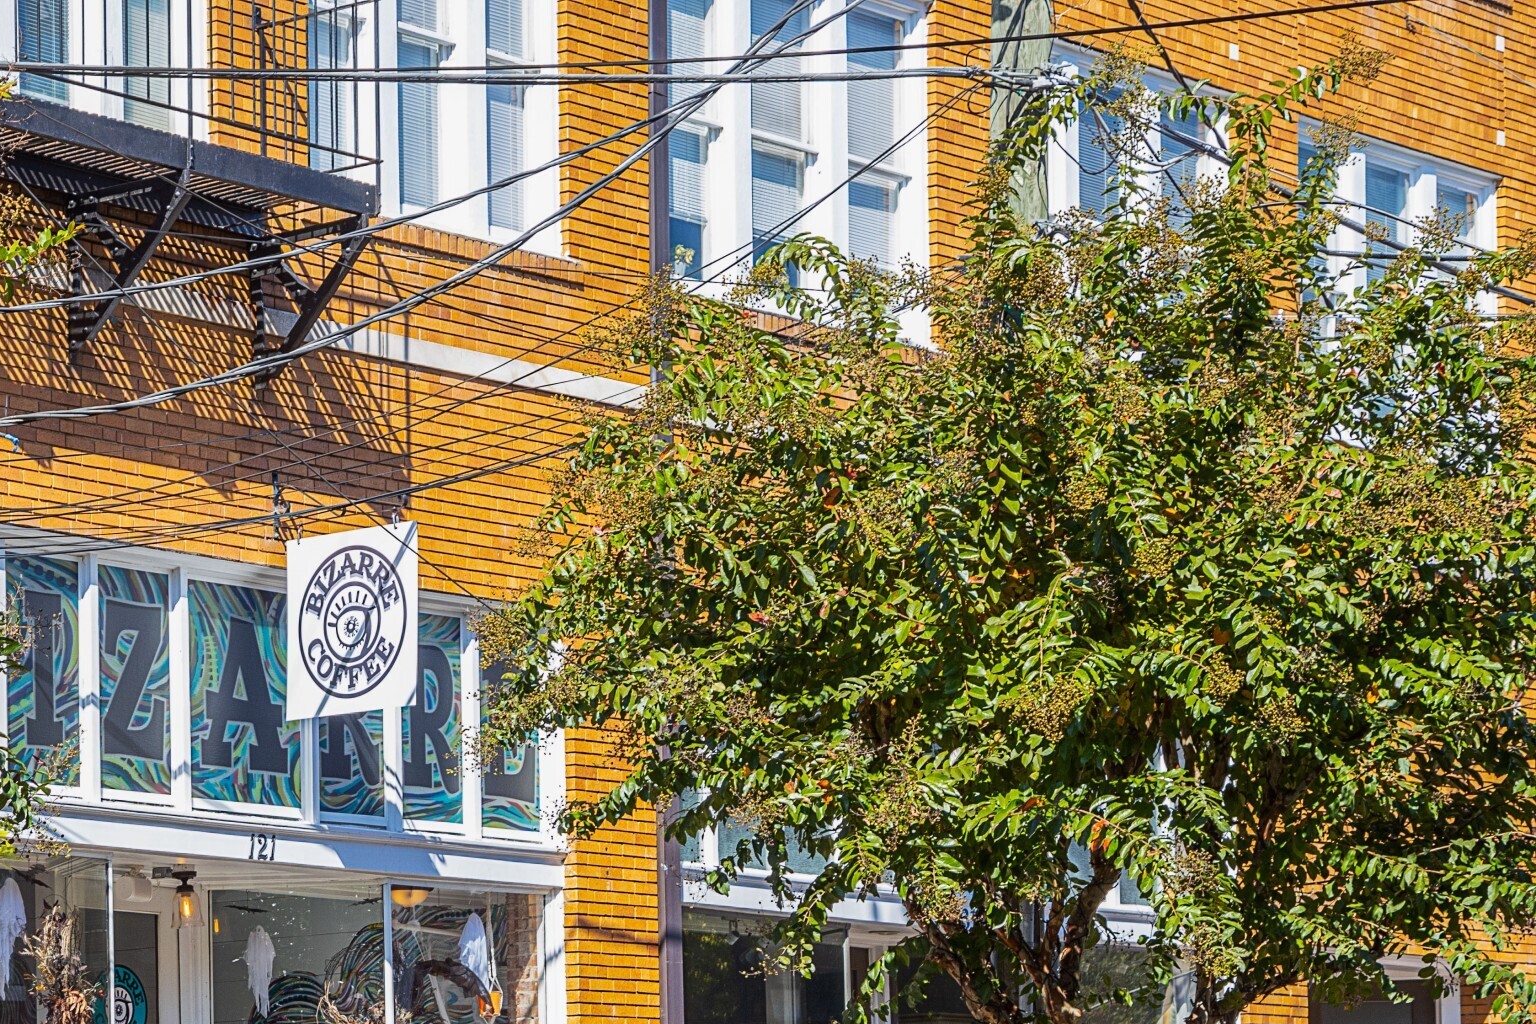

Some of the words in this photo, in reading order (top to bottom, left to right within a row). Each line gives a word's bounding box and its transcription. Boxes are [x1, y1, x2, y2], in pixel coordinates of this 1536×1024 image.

[305, 551, 400, 619] BIZARRE
[307, 636, 395, 691] COFFEE
[249, 834, 275, 861] 121
